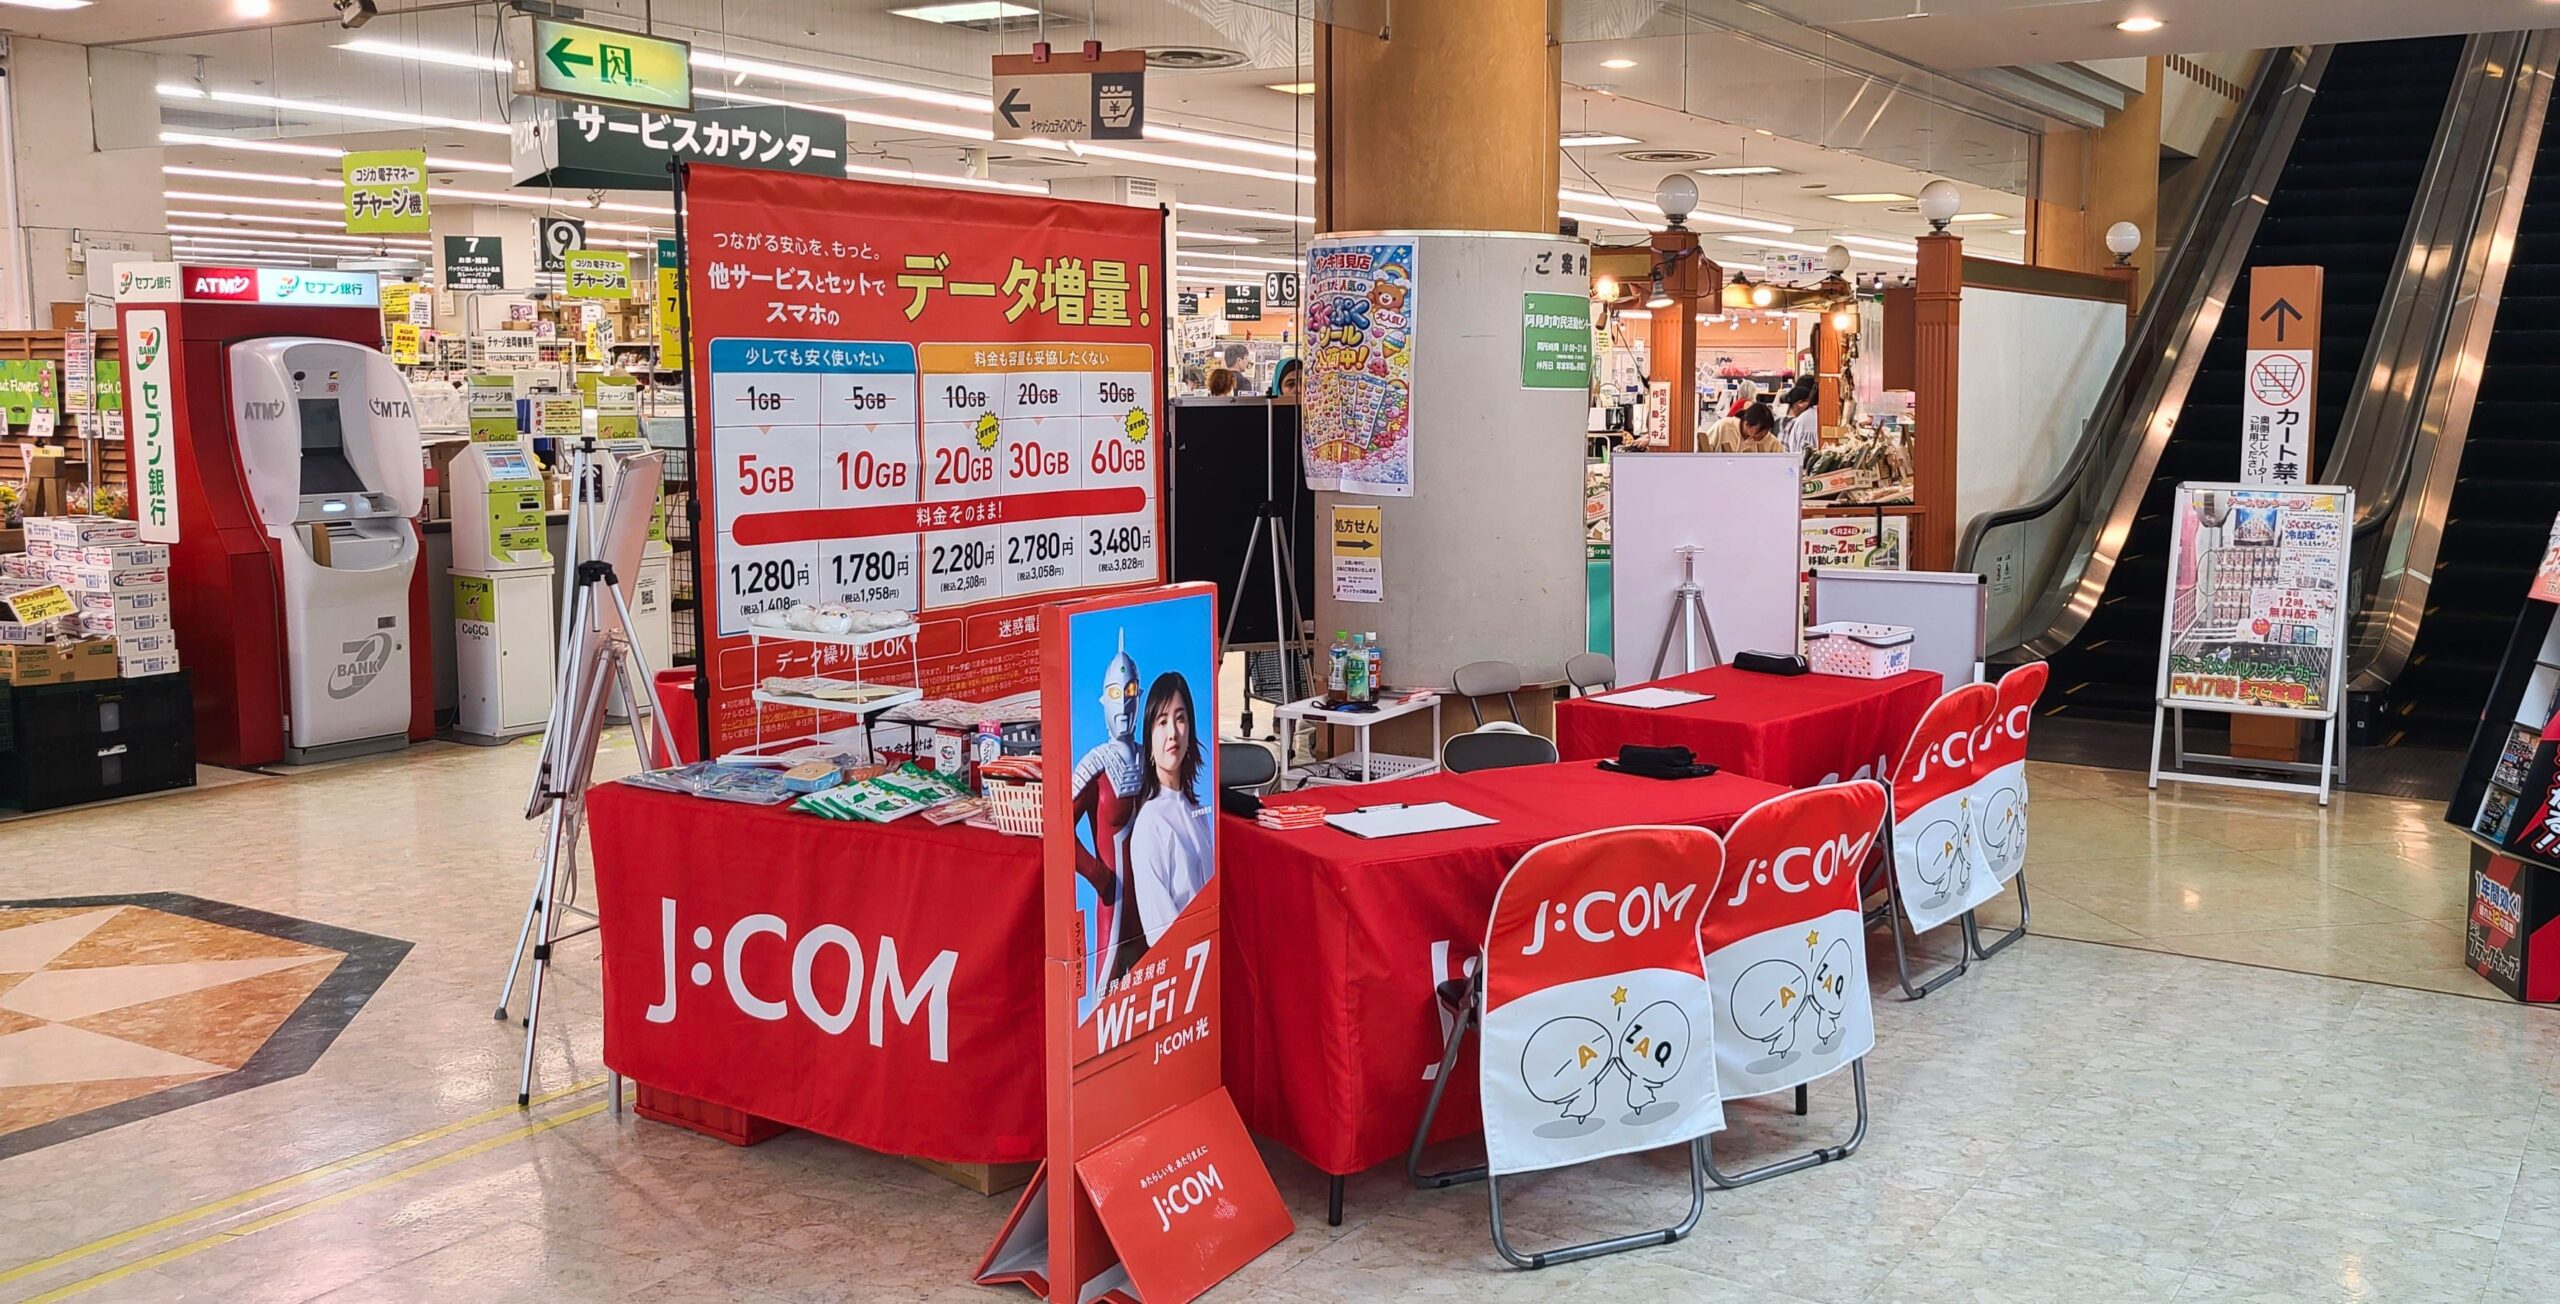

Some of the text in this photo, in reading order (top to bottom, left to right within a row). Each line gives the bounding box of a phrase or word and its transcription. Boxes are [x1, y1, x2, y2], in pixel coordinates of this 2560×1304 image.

[573, 105, 837, 167] サービスカウンター
[1030, 118, 1087, 133] キャッシュディスペンサー
[352, 188, 423, 219] チャージ機
[465, 237, 479, 253] 7
[553, 225, 574, 257] 9
[713, 231, 880, 261] つながる安心を、もっと。
[1535, 251, 1588, 276] ご案内
[134, 275, 172, 290] セブン銀行
[195, 276, 237, 293] ATM
[304, 280, 363, 296] セブン銀行
[572, 273, 629, 291] チャージ機
[707, 261, 887, 297] 他サービスとセットで
[896, 252, 1152, 329] データ増量!
[1235, 285, 1251, 297] 15
[1269, 277, 1276, 297] 5
[1285, 277, 1295, 298] 5
[765, 302, 840, 326] スマホの
[1376, 311, 1404, 326] 大人気!
[138, 345, 158, 356] BANK
[745, 347, 885, 367] 少しでも安く使いたい
[973, 350, 1110, 368] 料金も容量も妥協したくない
[471, 391, 513, 402] チャージ機
[747, 385, 781, 411] 1GB
[852, 385, 887, 411] 5GB
[945, 384, 987, 409] 10GB
[1018, 383, 1059, 405] 20GB
[1099, 381, 1136, 404] 50GB
[244, 400, 274, 421] ATM
[1651, 390, 1660, 439] 作動中
[1658, 388, 1667, 440] 防犯システム
[142, 379, 169, 527] セブン銀行
[1090, 439, 1146, 475] 60GB
[2246, 415, 2260, 476] ご利用ください
[2257, 415, 2271, 484] 奥側エレベーター
[2272, 408, 2300, 484] カート禁
[836, 450, 907, 491] 10GB
[934, 446, 994, 485] 20GB
[1008, 441, 1070, 479] 30GB
[738, 454, 795, 496] 5GB
[916, 500, 1003, 527] 料金そのまま!
[1334, 518, 1379, 534] 処方せん
[1007, 532, 1074, 565] 2,780円
[1088, 526, 1152, 557] 3,480円
[1804, 540, 1864, 555] 1階から2階に
[832, 550, 910, 587] 1,780円
[931, 541, 995, 575] 2,280円
[1098, 557, 1145, 573] (税込3,828円)
[1808, 554, 1856, 566] 移動します!
[731, 558, 810, 597] 1,280円
[940, 576, 988, 593] (税込2,508円)
[1016, 566, 1065, 582] (税込3,058円)
[459, 582, 489, 593] チャージ機
[841, 586, 900, 604] (税込1,958円)
[2268, 607, 2318, 620] 無料配布
[337, 659, 380, 678] BANK
[1979, 705, 2029, 751] J:C
[1944, 840, 1954, 857] A
[1728, 832, 1871, 907] J:COM
[2475, 870, 2521, 922] 1年間効く!
[1521, 882, 1697, 956] J:COM
[645, 896, 959, 1063] J:COM
[1816, 962, 1844, 999] ZAQ
[1096, 939, 1211, 1055] Wi-Fi 7
[1779, 986, 1797, 1009] A
[1153, 1016, 1210, 1065] J:COM 光
[1625, 1023, 1673, 1069] ZAQ
[1578, 1044, 1599, 1070] A
[1140, 1145, 1209, 1190] あたらしいを、あたりまえに
[1152, 1163, 1224, 1232] J:COM
